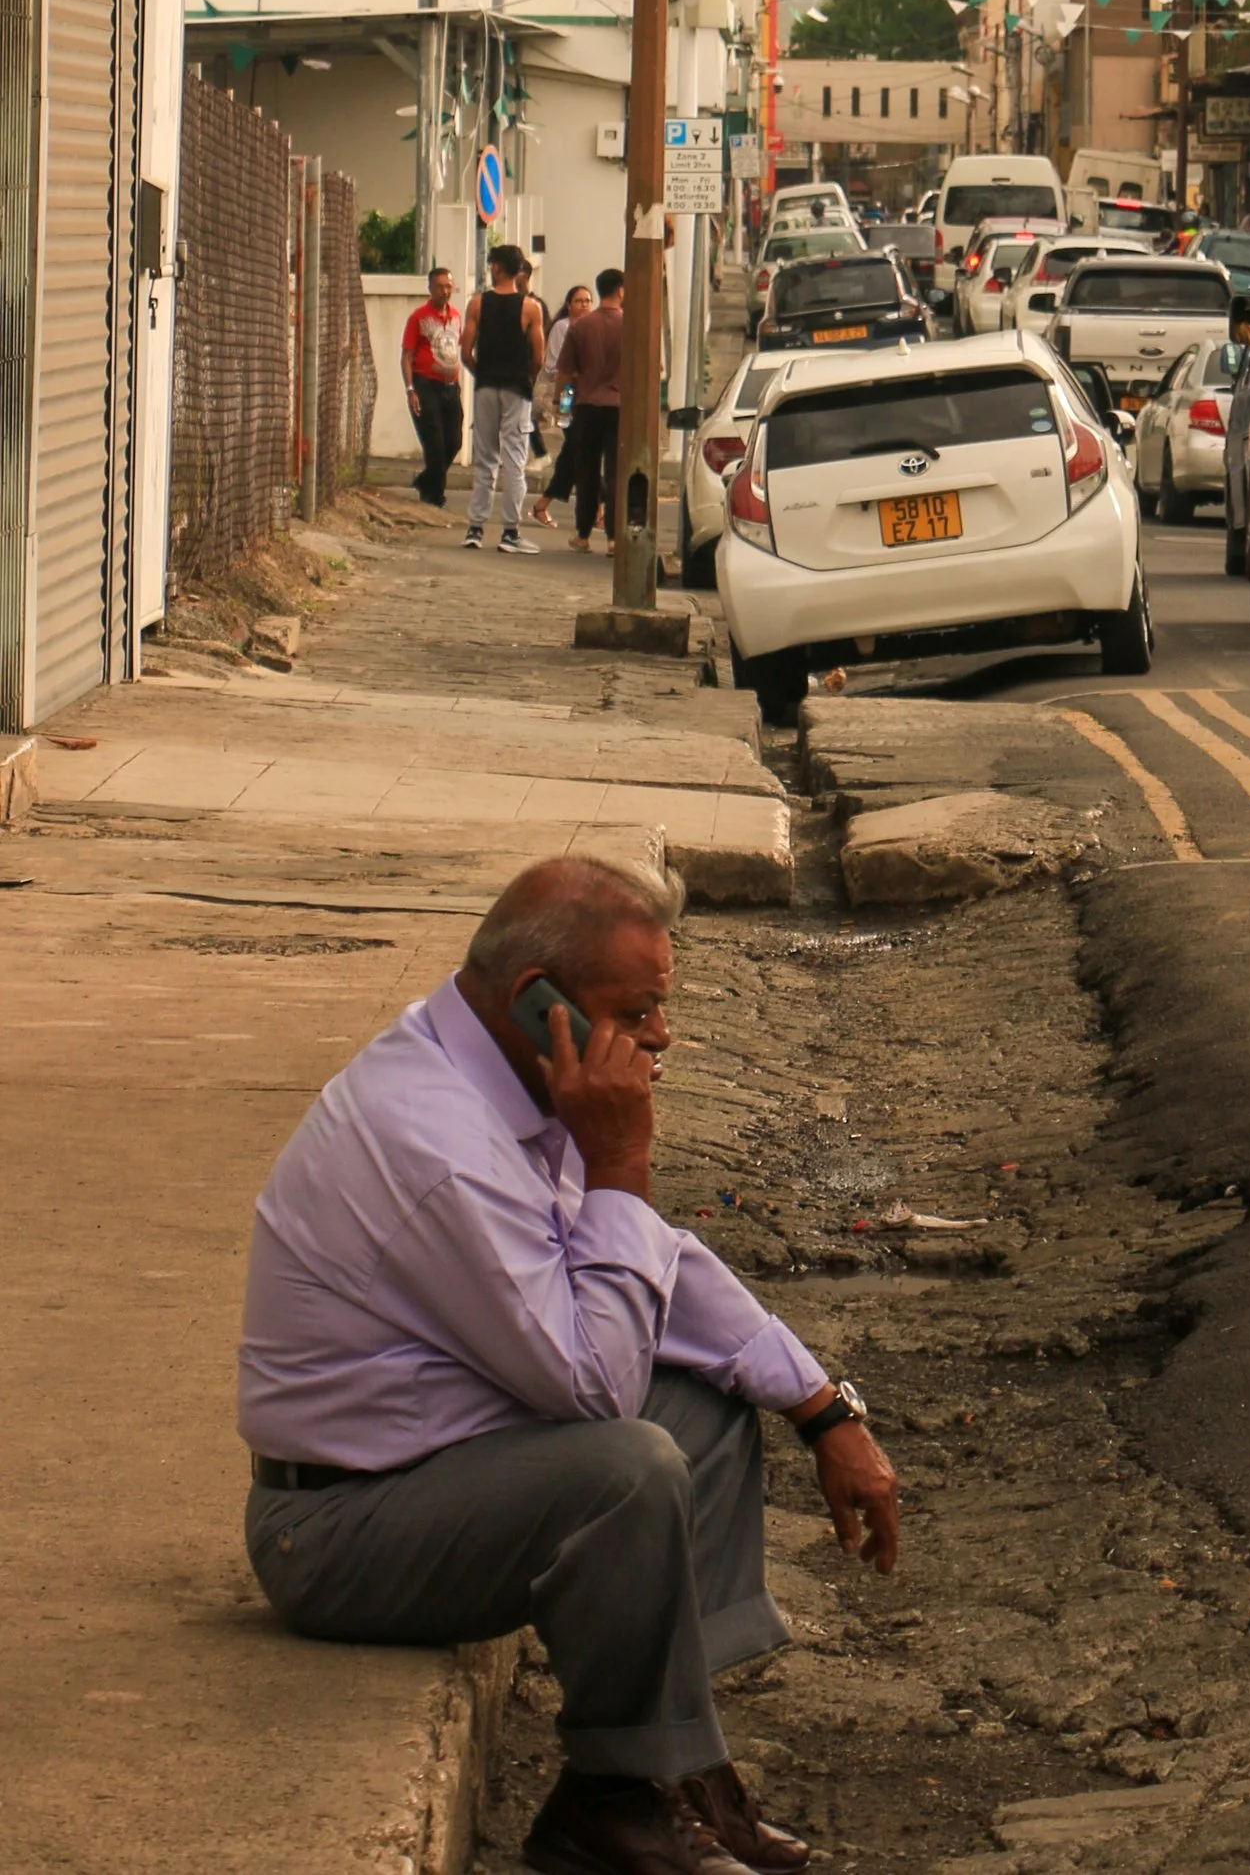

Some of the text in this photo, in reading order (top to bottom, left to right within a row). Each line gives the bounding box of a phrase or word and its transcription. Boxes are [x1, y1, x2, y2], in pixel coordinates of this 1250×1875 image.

[676, 153, 697, 161] Zone
[894, 495, 946, 521] 5810
[891, 516, 949, 543] EZ 17
